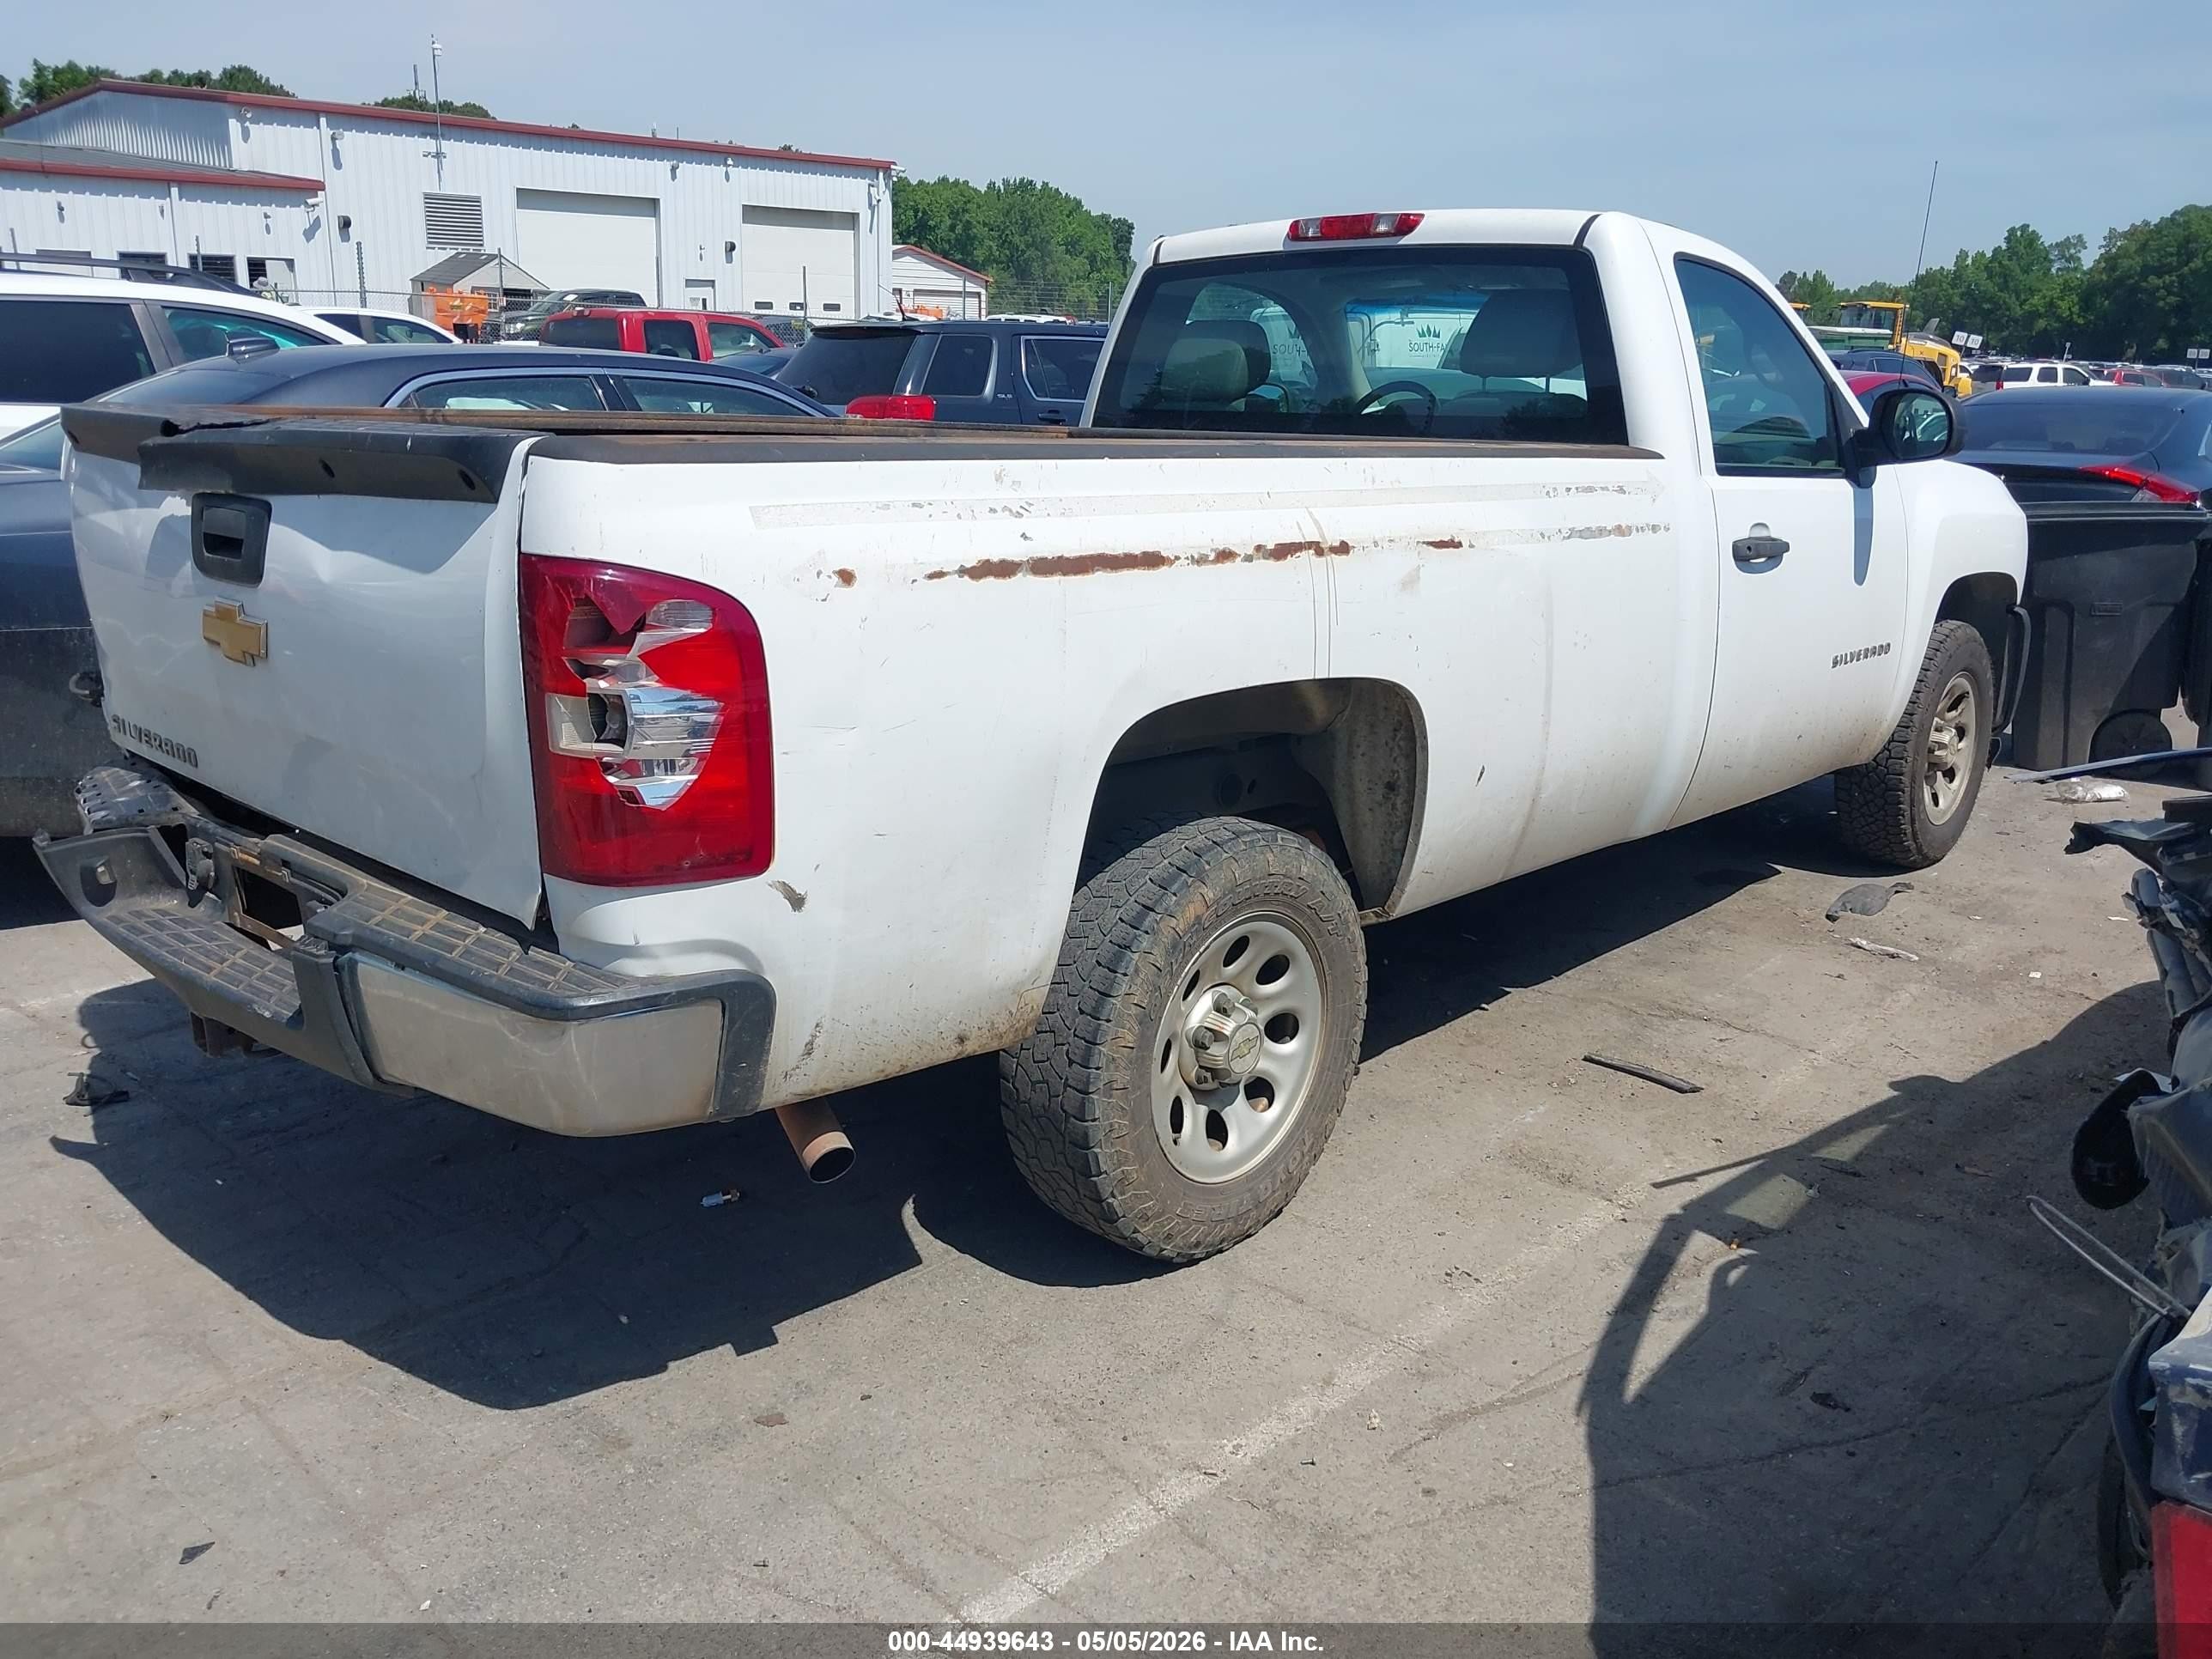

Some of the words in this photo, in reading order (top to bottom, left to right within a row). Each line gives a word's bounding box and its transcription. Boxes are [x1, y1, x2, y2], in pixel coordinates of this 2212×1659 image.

[1408, 342, 1447, 353] SOUTH-FA
[1831, 641, 1891, 669] SILVERADO
[111, 714, 198, 769] SILVERADO
